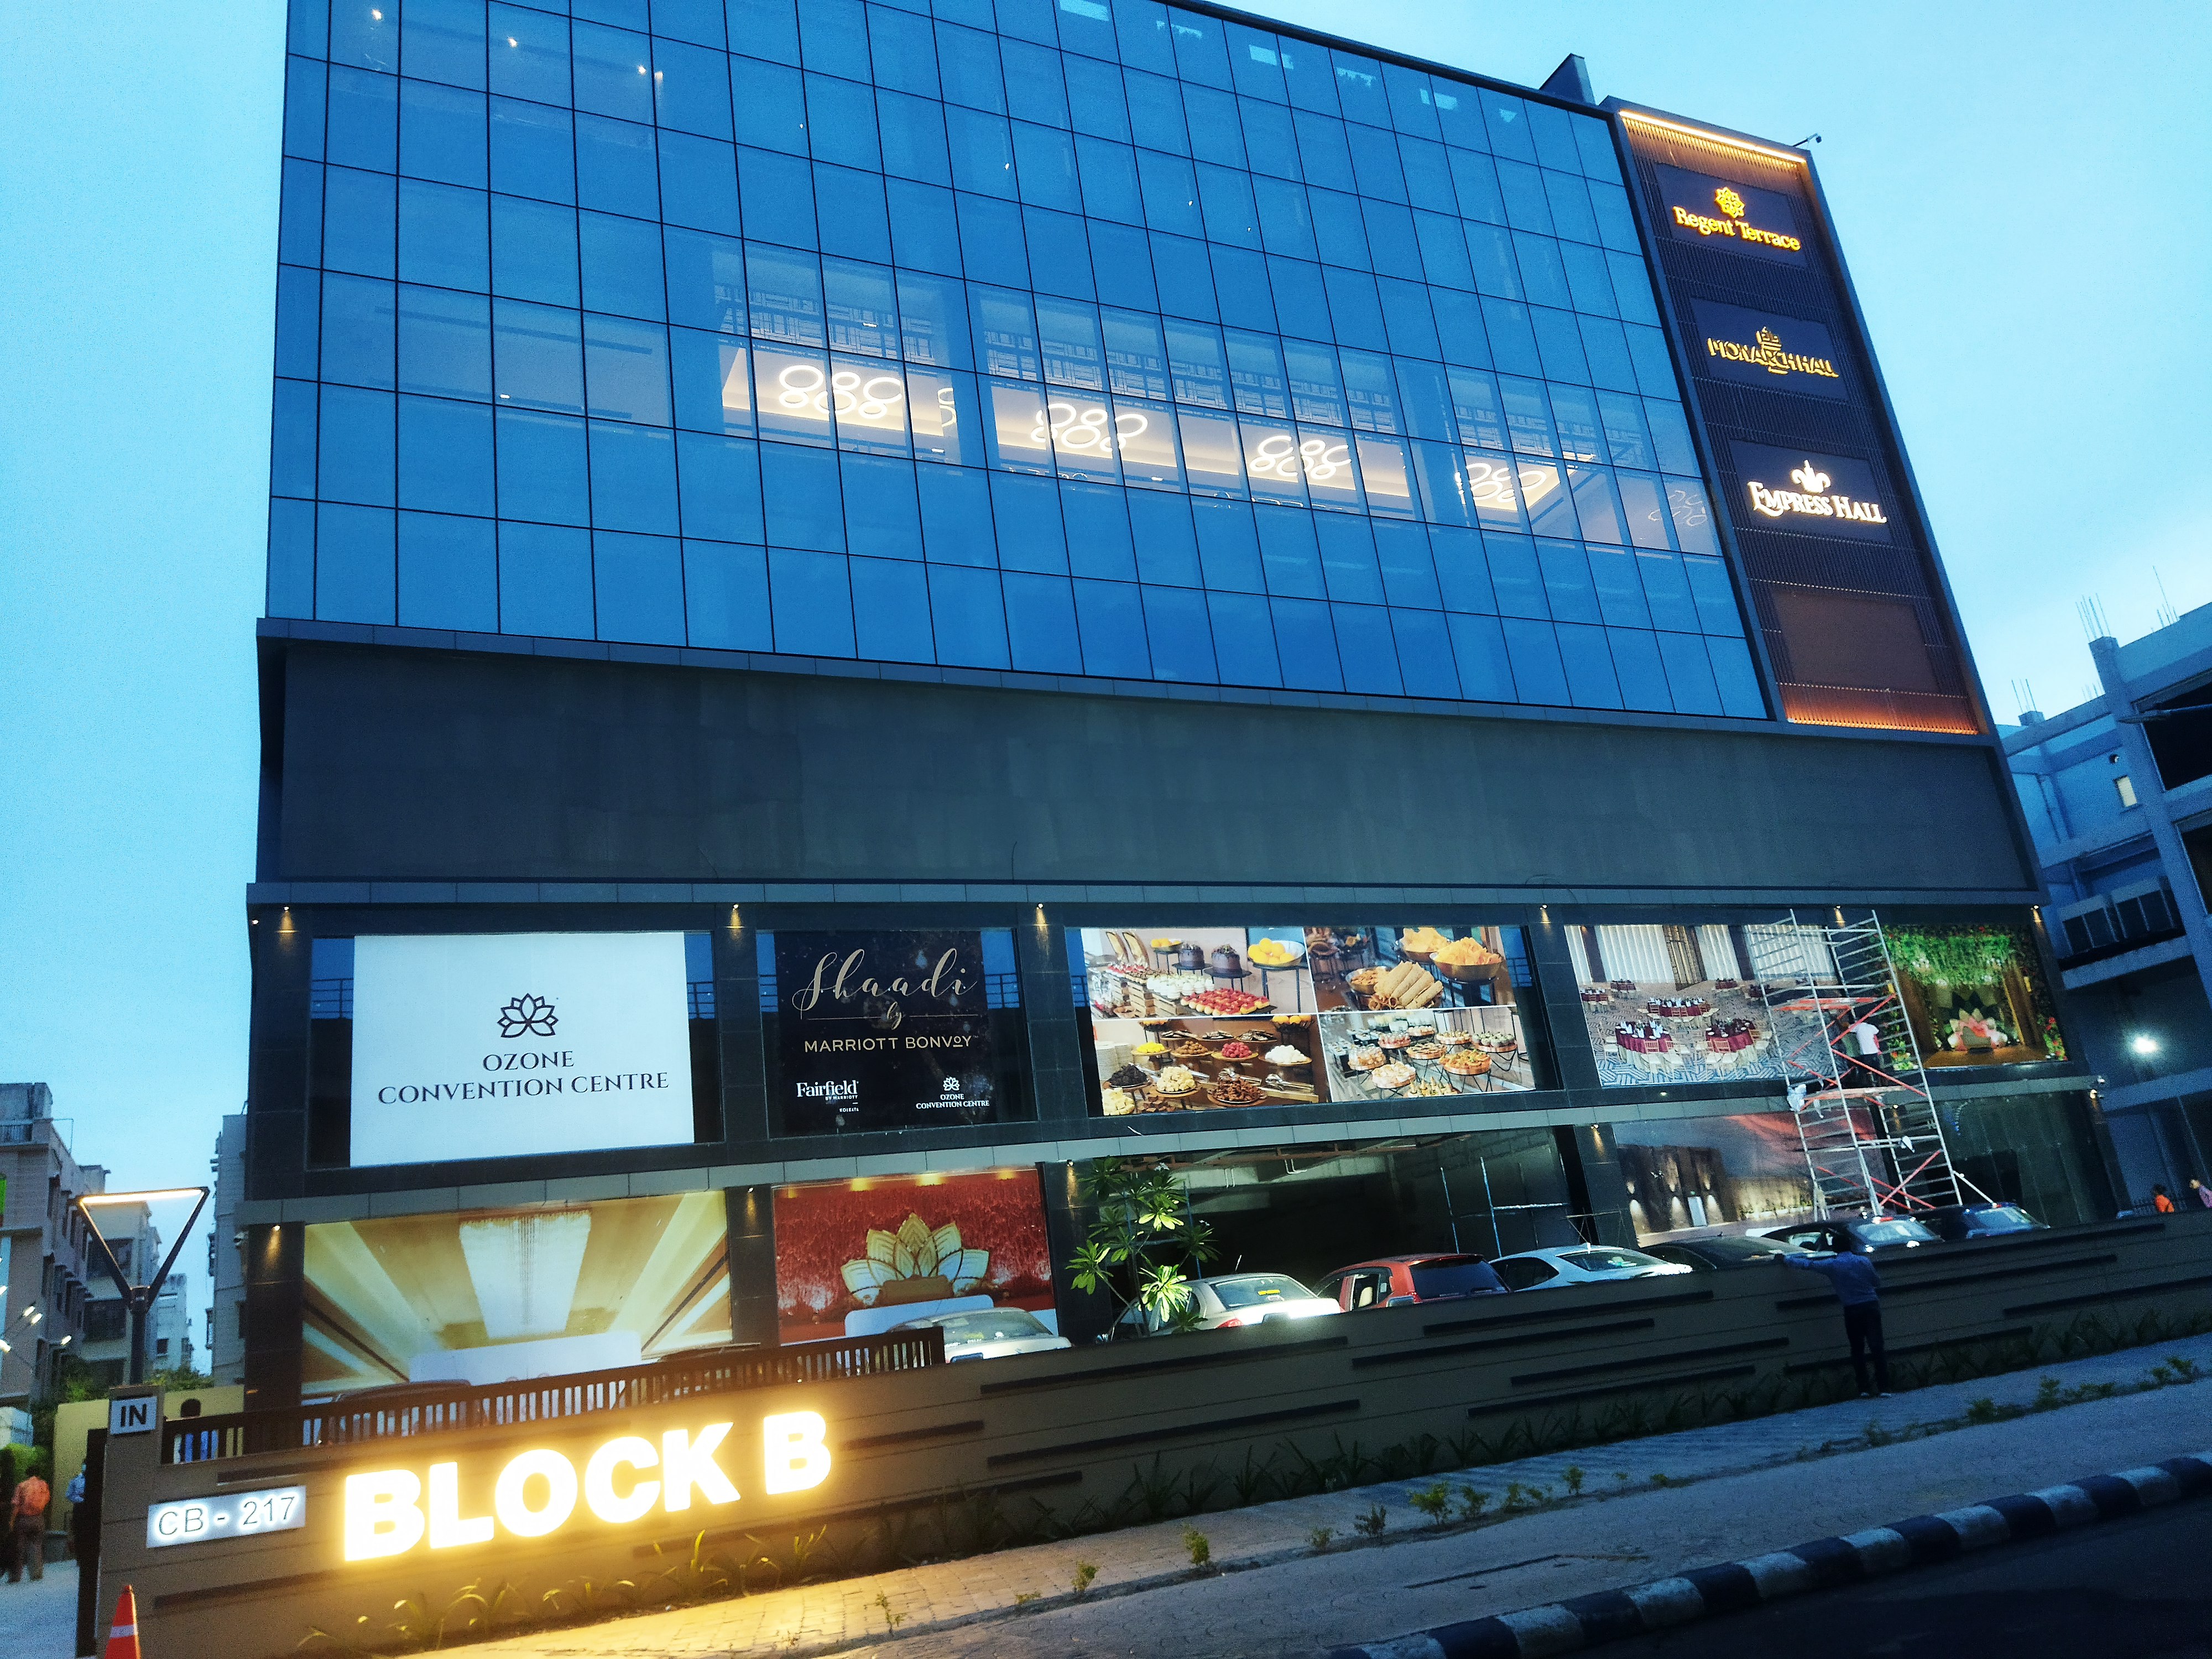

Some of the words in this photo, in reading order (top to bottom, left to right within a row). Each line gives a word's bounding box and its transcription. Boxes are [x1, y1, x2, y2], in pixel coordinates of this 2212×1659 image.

[1673, 206, 1735, 236] Regent
[1734, 220, 1802, 252] Terrace
[792, 948, 978, 1020] Shaadi
[886, 1001, 906, 1030] by
[805, 1037, 899, 1053] MARRIOTT
[482, 1050, 575, 1072] OZONE
[378, 1077, 562, 1105] CONVENTION
[571, 1072, 669, 1094] CENTRE
[796, 1080, 858, 1098] Fairfield
[916, 1101, 962, 1109] CONVENTION
[120, 1404, 147, 1427] IN
[345, 1421, 740, 1562] BLOCK
[764, 1411, 832, 1495] B
[159, 1507, 204, 1535] CB
[243, 1496, 295, 1526] 217
